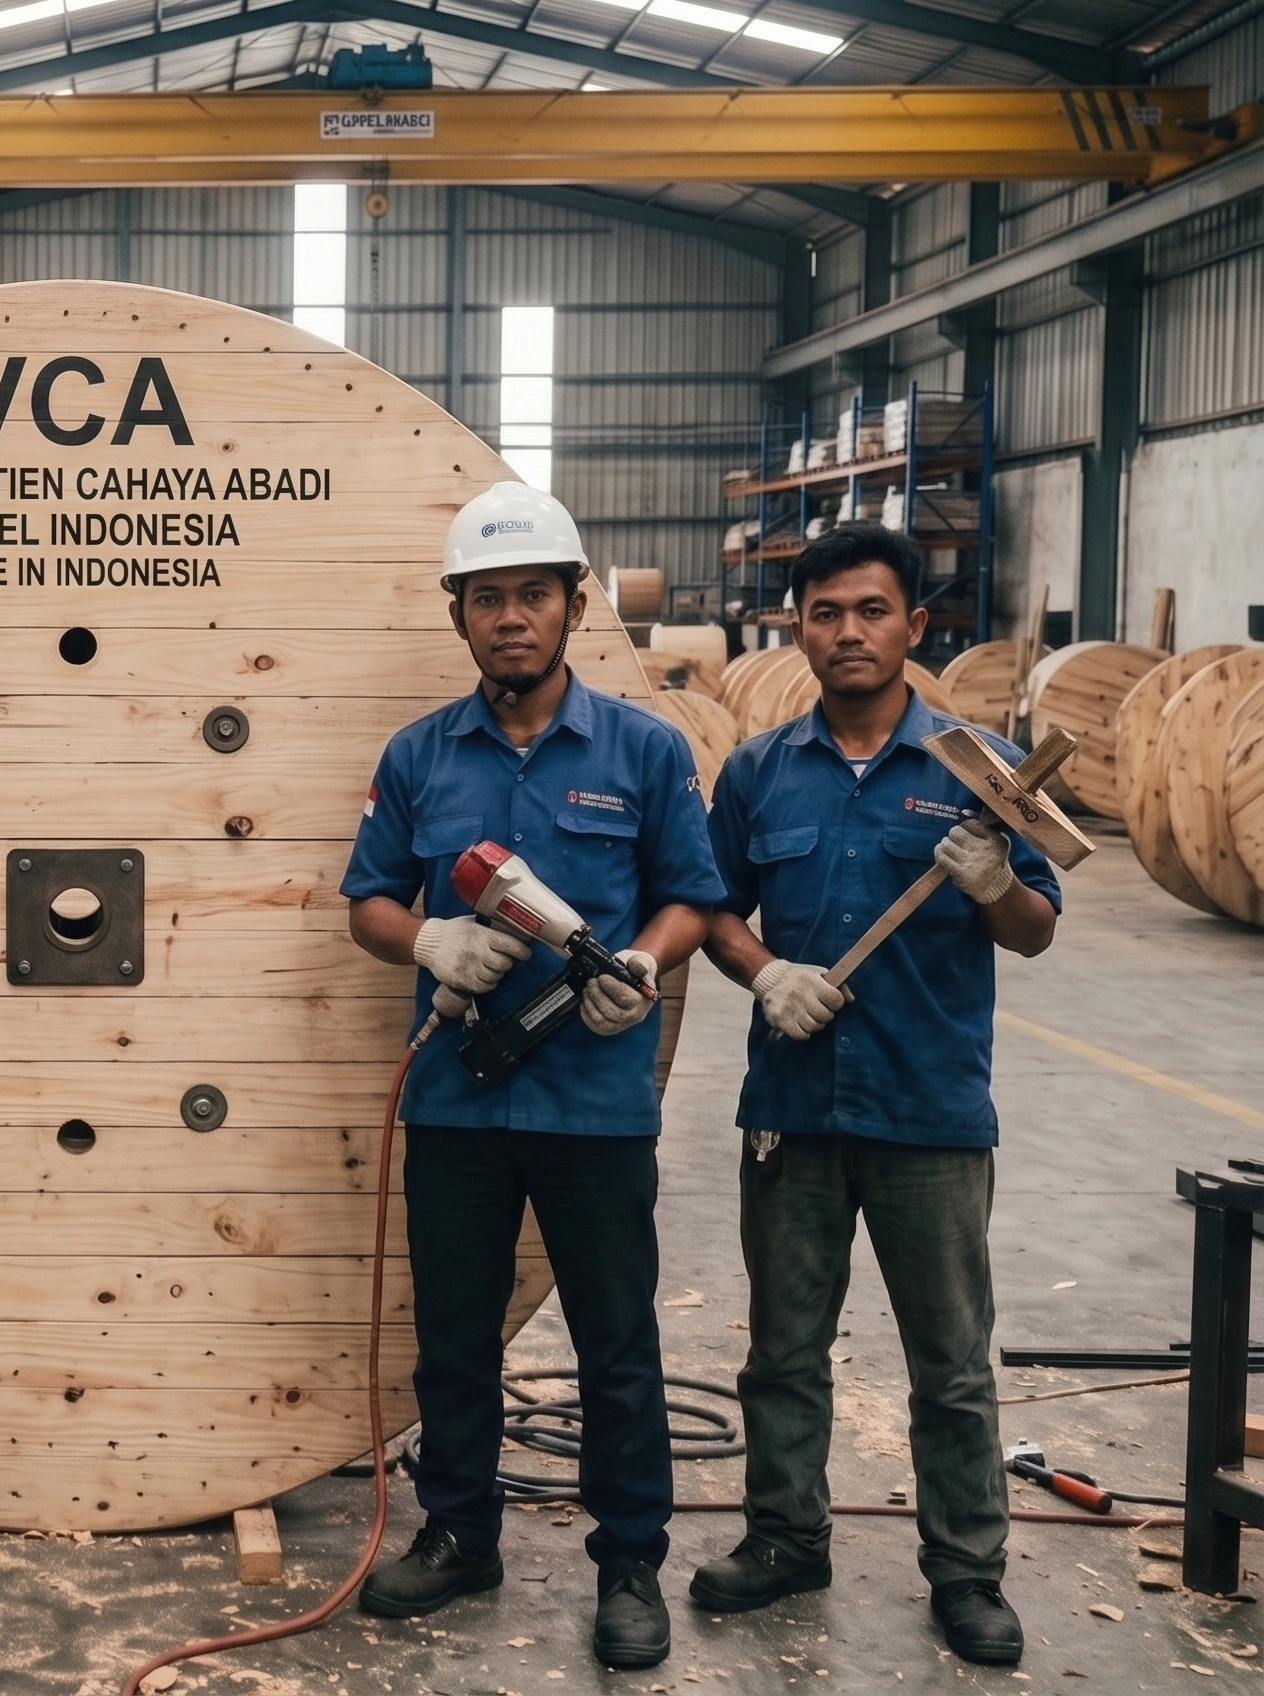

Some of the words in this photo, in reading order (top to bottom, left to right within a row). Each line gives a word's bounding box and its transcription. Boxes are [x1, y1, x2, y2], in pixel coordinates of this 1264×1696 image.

[76, 467, 216, 501] CAHAYA
[222, 467, 331, 502] ABADI
[50, 513, 241, 547] INDONESIA
[18, 557, 46, 587] IN
[55, 557, 222, 588] INDONESIA
